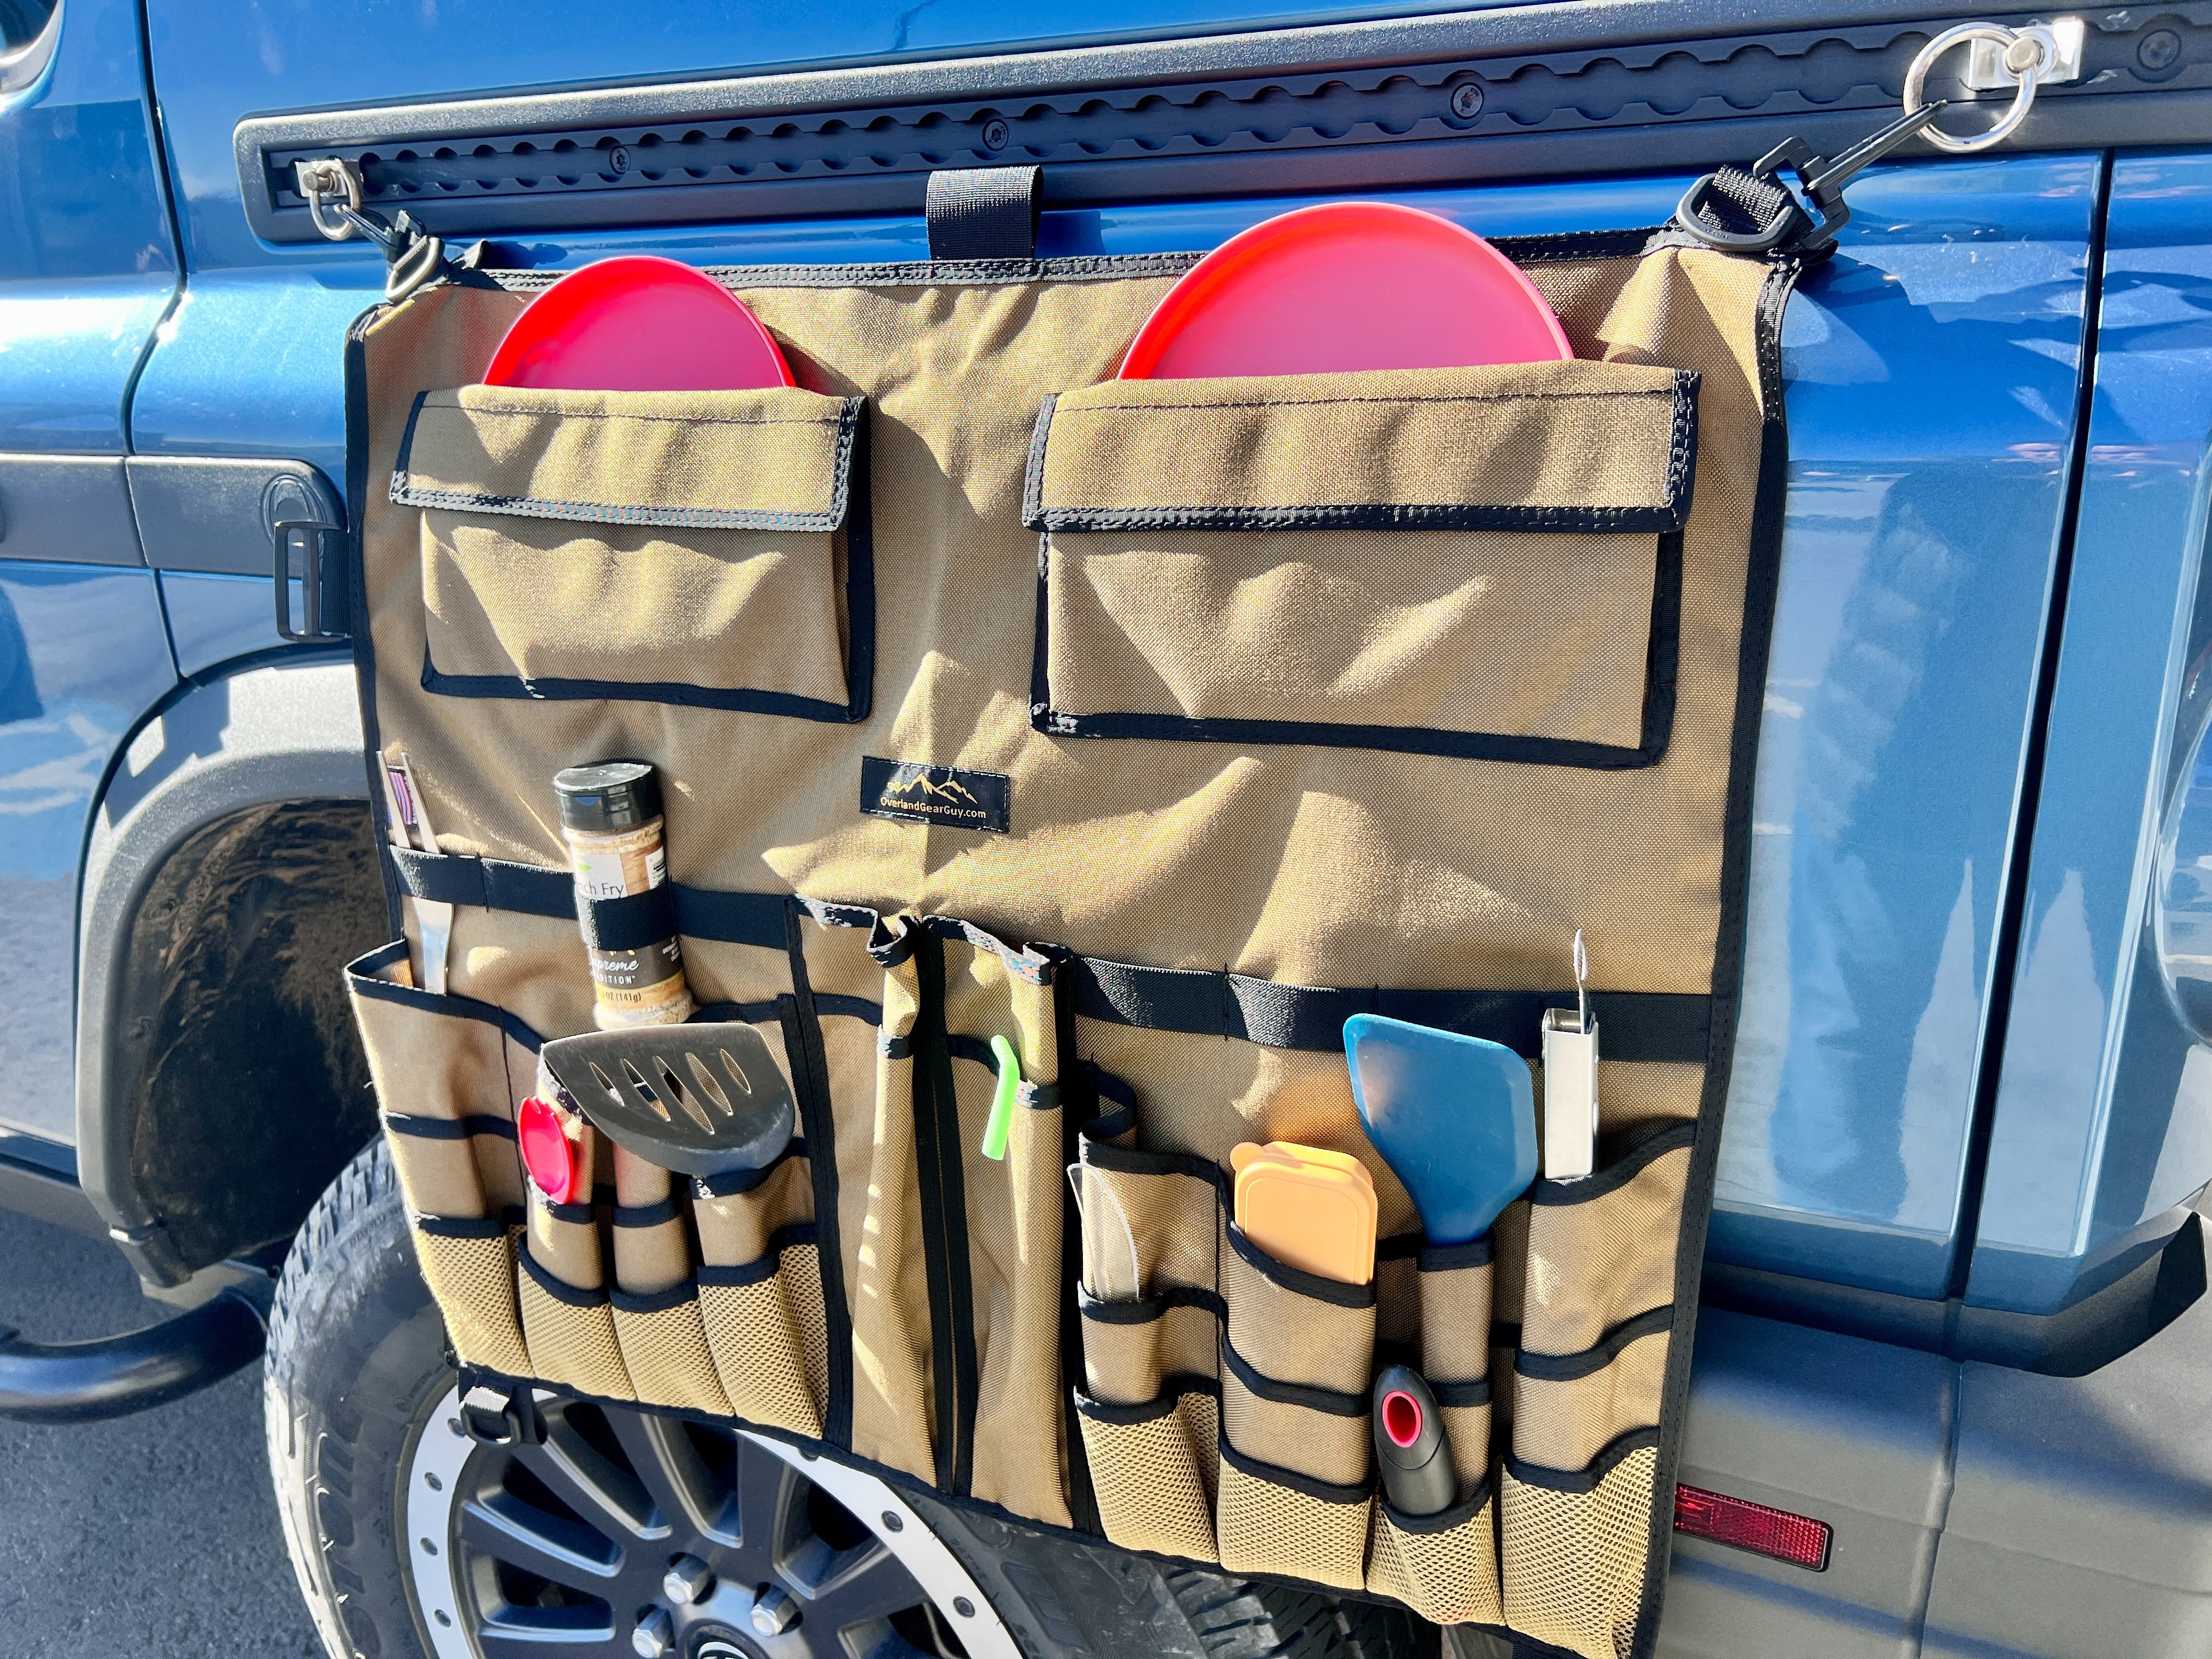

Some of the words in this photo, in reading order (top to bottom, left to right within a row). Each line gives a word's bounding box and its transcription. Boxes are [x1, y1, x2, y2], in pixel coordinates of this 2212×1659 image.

[881, 797, 987, 819] OverlandGearGuy.com
[576, 882, 597, 895] nch
[601, 883, 624, 898] Fry
[591, 958, 639, 973] upreme
